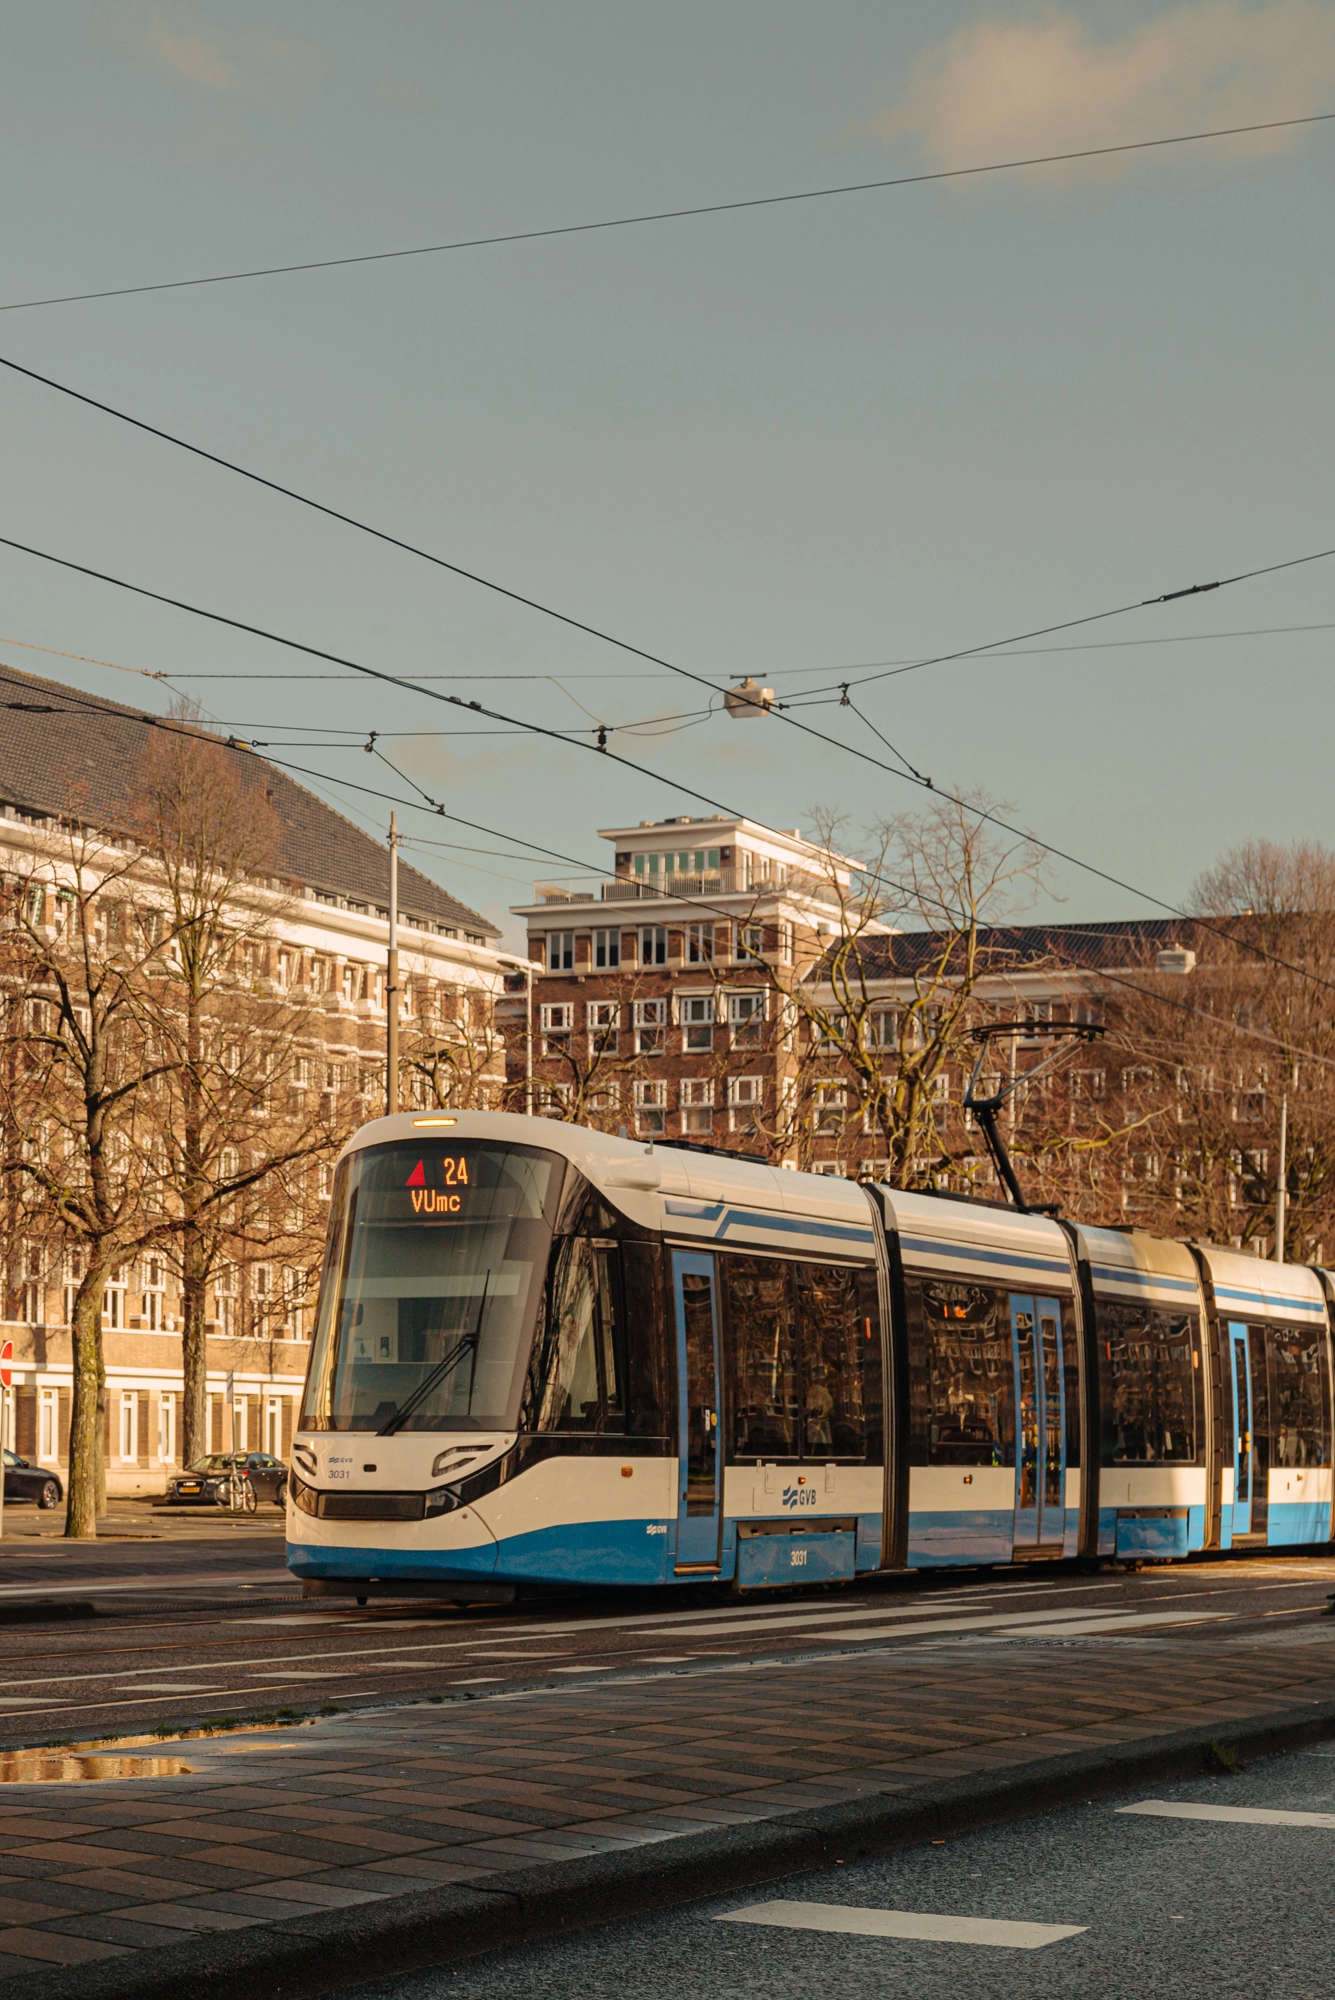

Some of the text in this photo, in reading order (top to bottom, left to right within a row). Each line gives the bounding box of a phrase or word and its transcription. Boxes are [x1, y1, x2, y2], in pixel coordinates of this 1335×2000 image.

[444, 1157, 468, 1185] 24
[411, 1189, 461, 1213] VUmc
[328, 1470, 350, 1479] 3031
[799, 1489, 816, 1505] GVB
[791, 1550, 807, 1566] 3031
